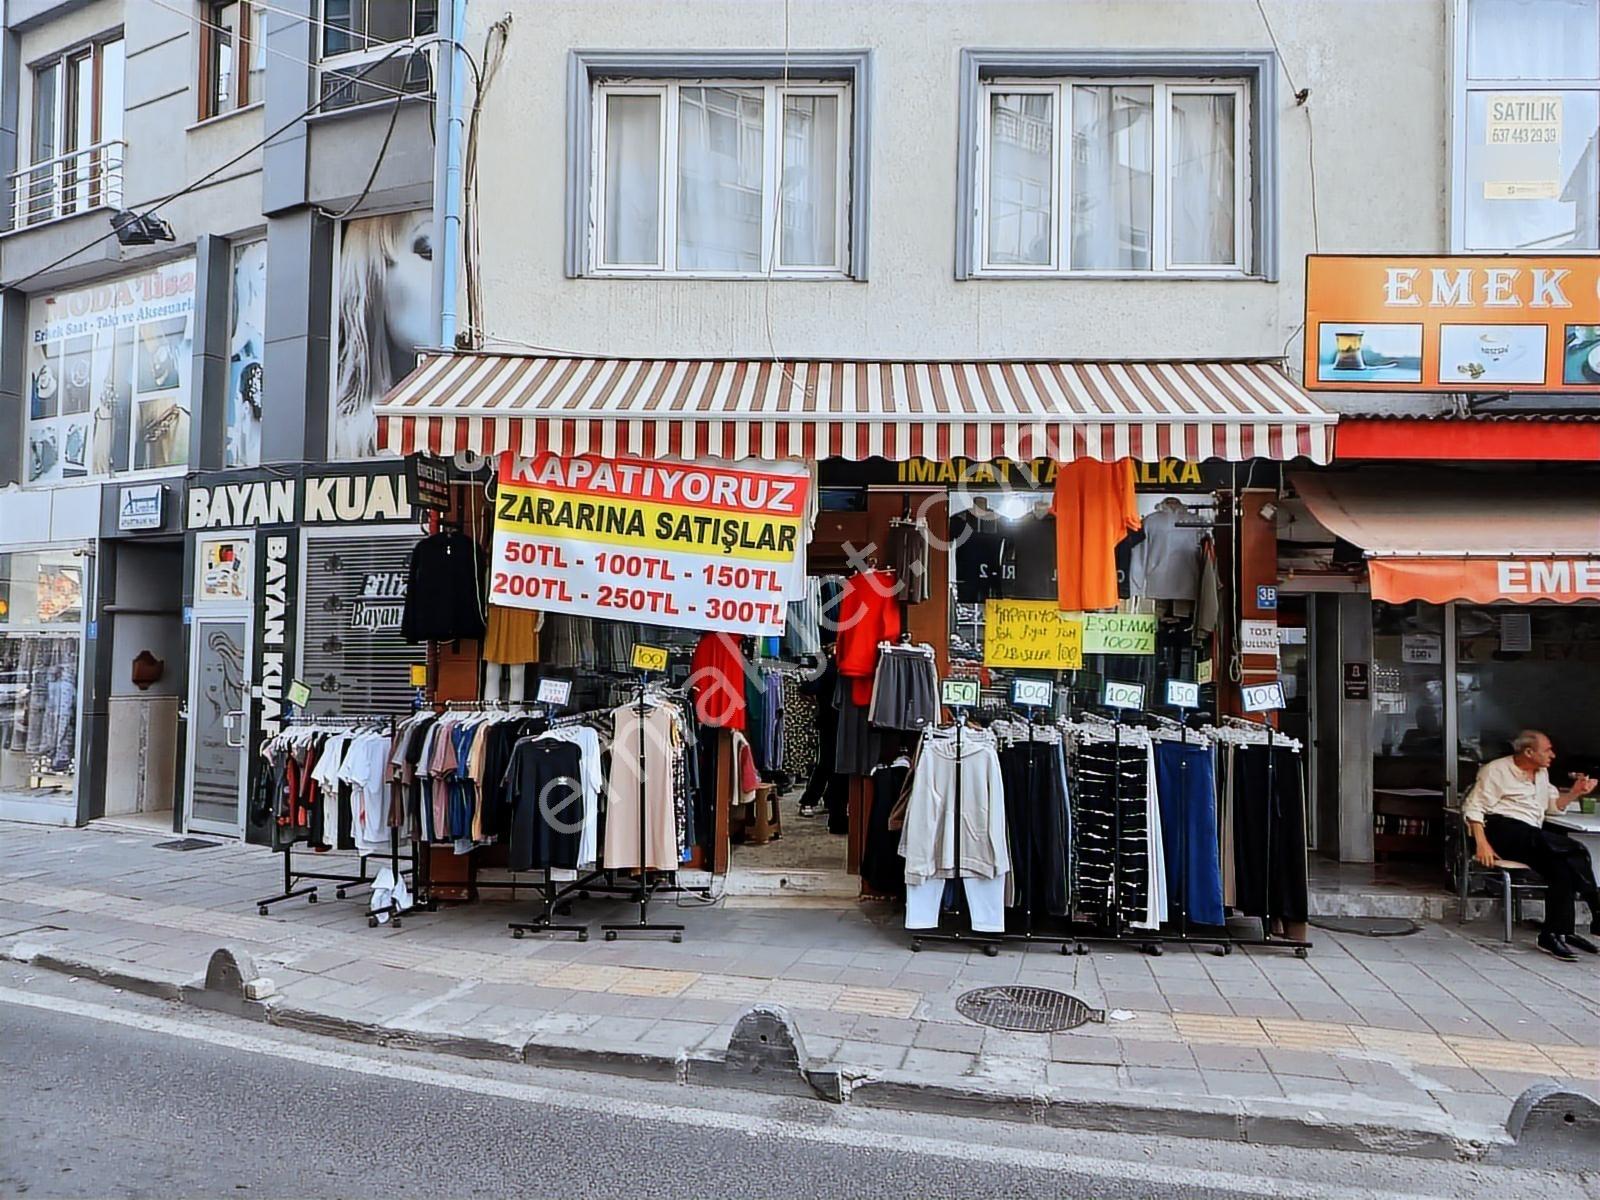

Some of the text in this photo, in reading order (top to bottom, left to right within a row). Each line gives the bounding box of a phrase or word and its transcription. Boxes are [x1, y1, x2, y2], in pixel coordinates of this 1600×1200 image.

[1492, 102, 1557, 121] SATILIK
[1383, 267, 1573, 309] EMEK
[510, 453, 796, 512] KAPATIYORUZ
[187, 479, 295, 529] BAYAN
[497, 492, 797, 554] ZARARINA SATIŞLAR
[504, 541, 568, 569] 50TL
[594, 552, 676, 582] 100TL
[702, 564, 783, 593] 150TL
[264, 536, 288, 644] BAYAN
[492, 573, 573, 603] 200TL
[596, 585, 680, 616] 250TL
[704, 598, 784, 626] 300TL
[1259, 587, 1276, 601] 3B
[351, 601, 405, 634] Bayan
[1249, 627, 1273, 637] TOST
[944, 683, 974, 702] 150
[1169, 685, 1195, 702] 150
